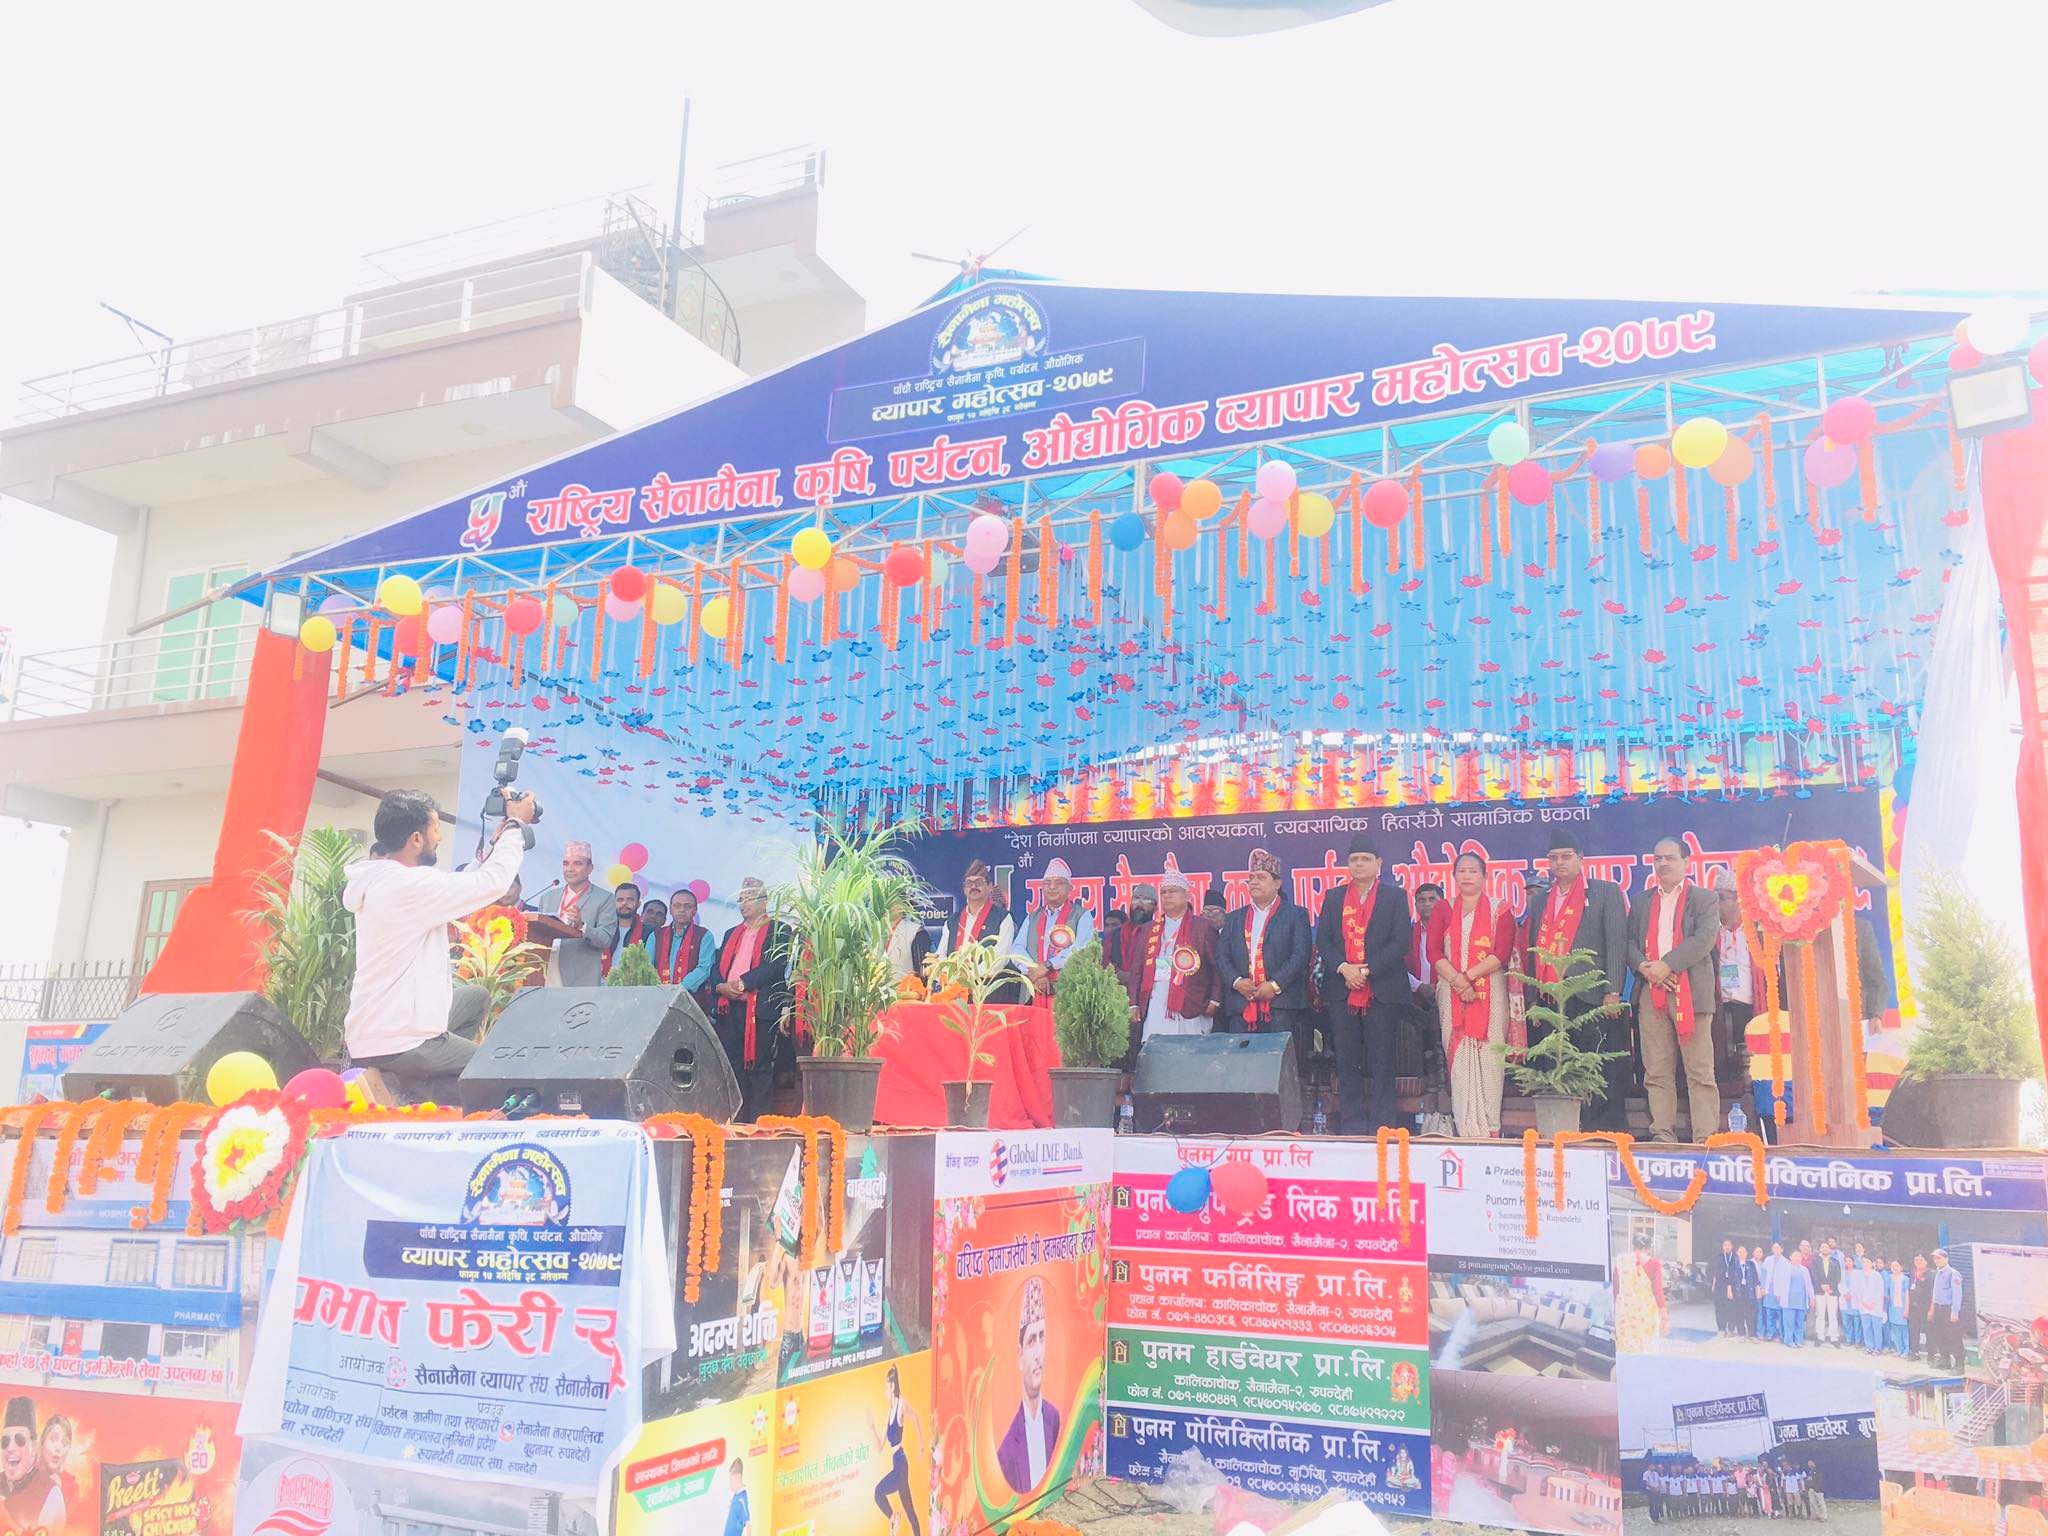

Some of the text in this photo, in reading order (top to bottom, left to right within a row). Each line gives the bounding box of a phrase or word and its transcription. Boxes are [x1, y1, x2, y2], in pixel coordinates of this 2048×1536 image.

[994, 295, 1042, 331] महोत्सव
[872, 367, 1113, 422] व्यापार महोत्सव-२०७९
[526, 485, 635, 537] राष्ट्रिय
[888, 436, 1011, 491] पर्यटन,
[1023, 400, 1209, 471] औद्योगिक
[1216, 372, 1364, 433] व्यापार
[1371, 311, 1716, 407] महोत्सव-२०७९
[1037, 828, 1098, 848] निर्माणमा
[1103, 822, 1173, 850] व्यापारको
[1274, 817, 1369, 842] व्यवसायिक
[1452, 807, 1535, 835] सामाजिक
[1010, 1141, 1084, 1165] Global IME Bank
[522, 1148, 565, 1197] महोत्सव
[1633, 1154, 1697, 1183] पुनम
[1905, 1166, 1993, 1199] प्रा.लि.
[1286, 1185, 1338, 1222] लिंक
[1486, 1194, 1517, 1206] Punam
[1586, 1199, 1600, 1211] Ltd
[401, 1246, 469, 1271] व्यापार
[1139, 1263, 1191, 1291] पुनम
[1316, 1268, 1393, 1301] प्रा.लि.
[174, 1309, 222, 1323] PHARMACY
[425, 1286, 565, 1356] फेरी
[1126, 1305, 1147, 1320] फोन
[138, 1359, 160, 1379] सेवा
[339, 1354, 385, 1375] आयोजक
[415, 1362, 476, 1387] सैनामैना
[480, 1370, 528, 1393] व्यापार
[555, 1372, 610, 1400] सैनामैना
[1140, 1340, 1391, 1381] पुनम हार्डवेयर प्रा.लि.
[1127, 1383, 1149, 1398] फोन
[312, 1405, 353, 1424] वाणिज्य
[1132, 1416, 1386, 1463] पुनम पोलिक्लिनिक प्रा.लि.
[456, 1453, 485, 1470] व्यापार
[1128, 1462, 1150, 1477] फोन
[106, 1468, 160, 1513] Preeti
